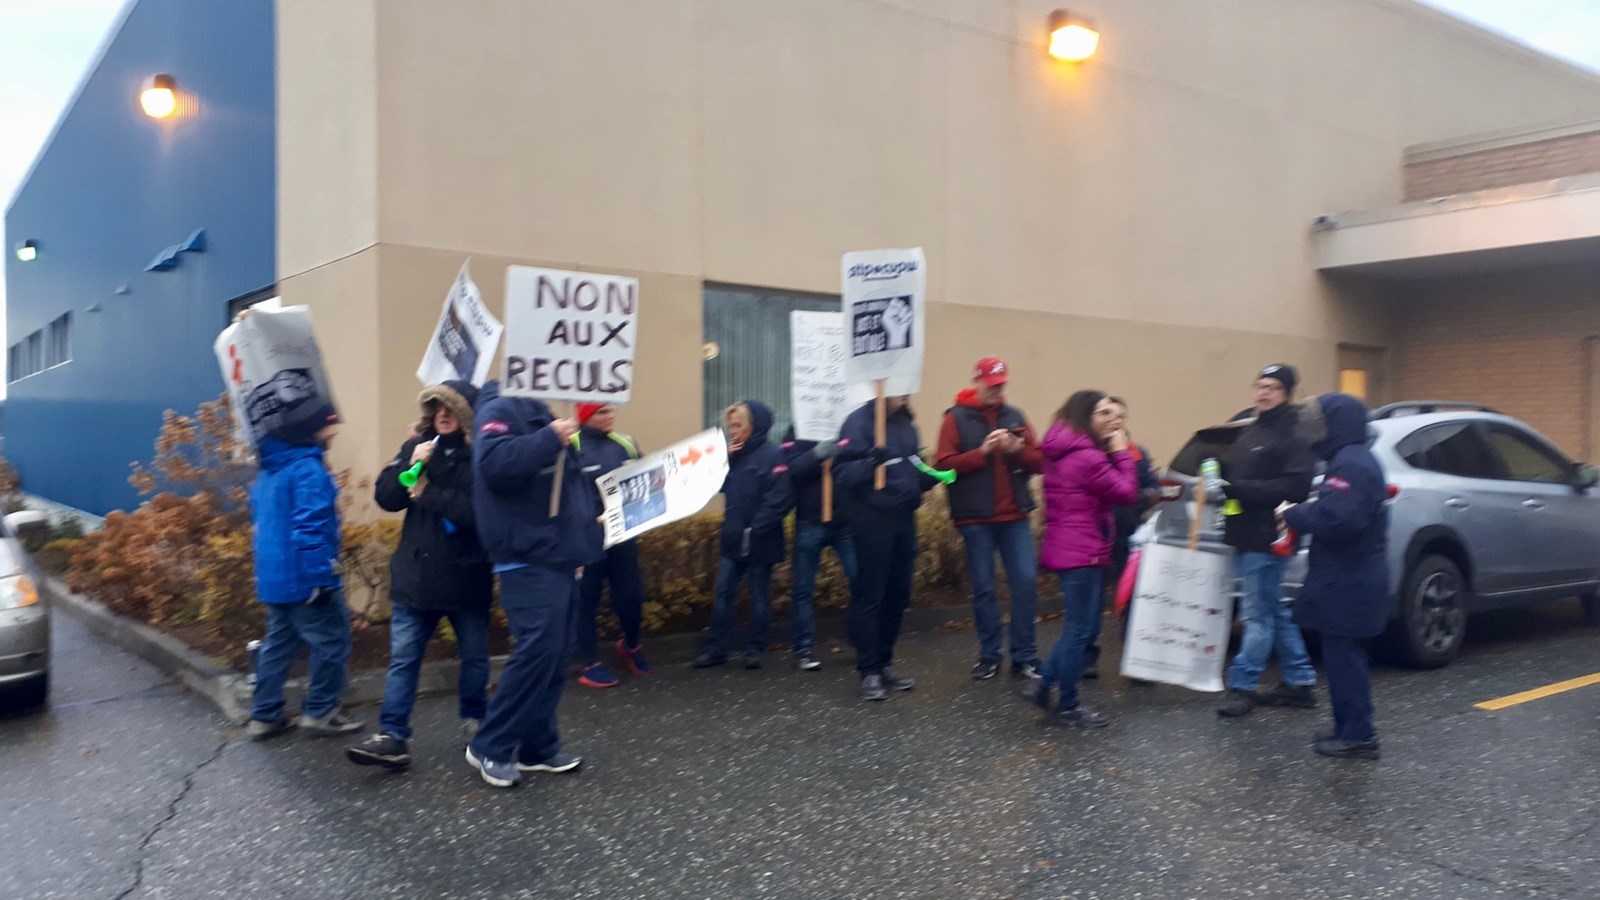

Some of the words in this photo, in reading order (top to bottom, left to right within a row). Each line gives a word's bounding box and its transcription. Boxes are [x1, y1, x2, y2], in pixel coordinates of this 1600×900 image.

[535, 275, 634, 315] NON
[546, 319, 631, 348] AUX
[505, 355, 633, 393] RECULS
